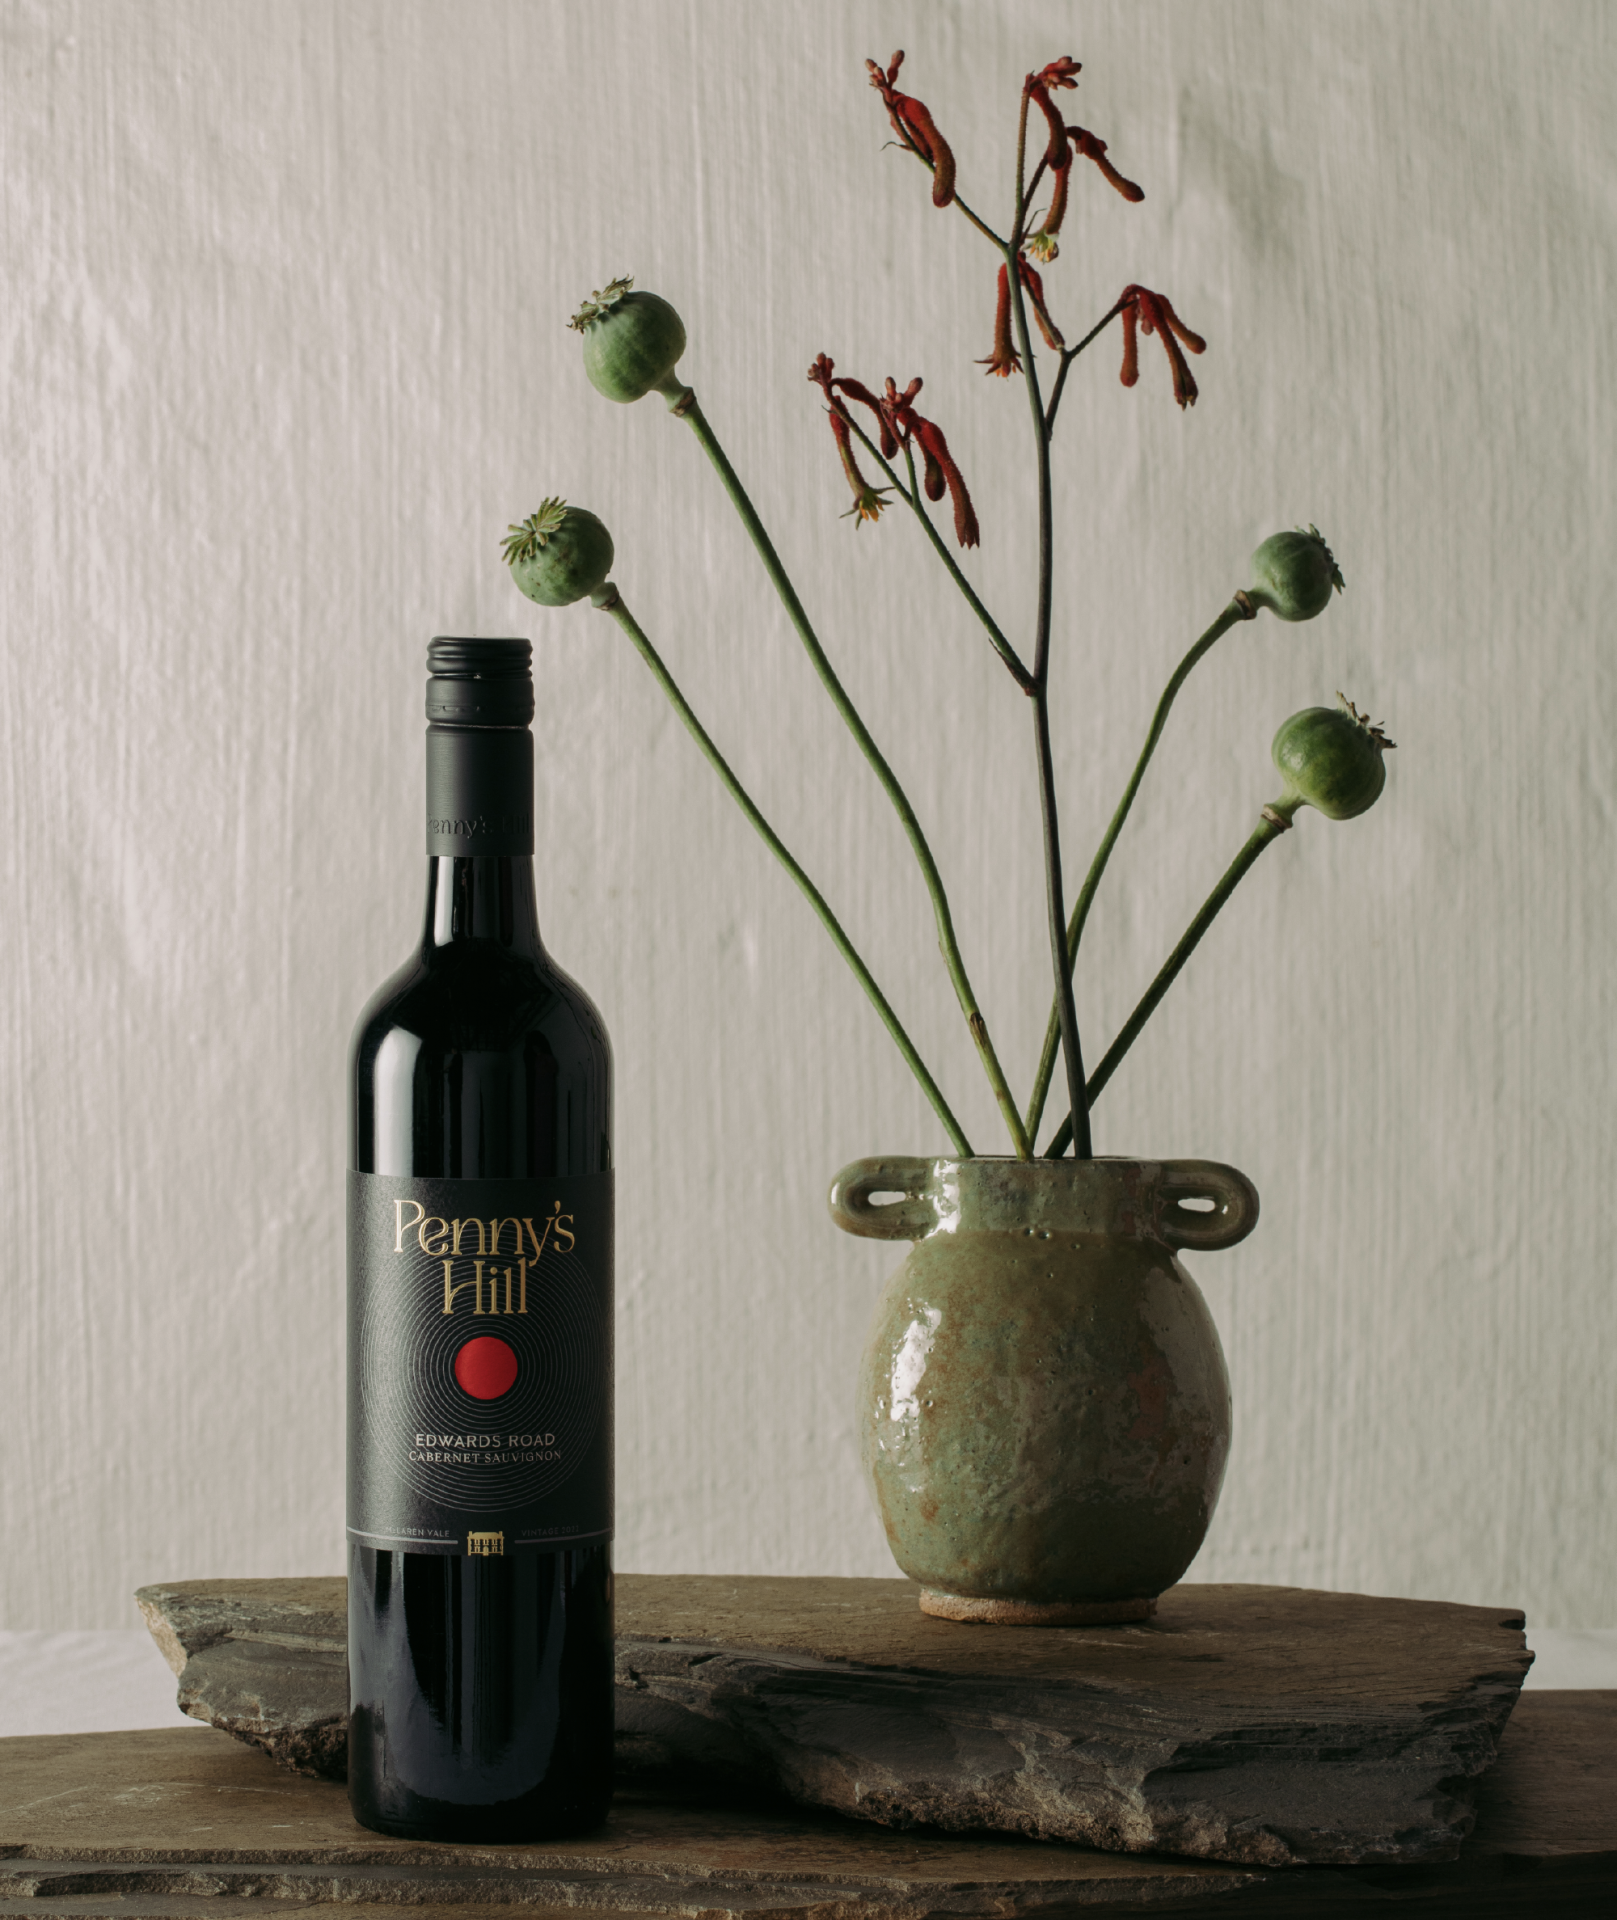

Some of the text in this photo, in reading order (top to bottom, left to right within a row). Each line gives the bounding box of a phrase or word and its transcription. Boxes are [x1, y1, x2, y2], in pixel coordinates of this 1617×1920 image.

[393, 1199, 575, 1267] Penny's
[442, 1257, 528, 1314] Hill
[416, 1433, 556, 1448] EDWARDS ROAD
[408, 1450, 562, 1463] CABERNET SAUVIGNON
[427, 1529, 450, 1538] VALE
[521, 1526, 559, 1537] VINTAGE
